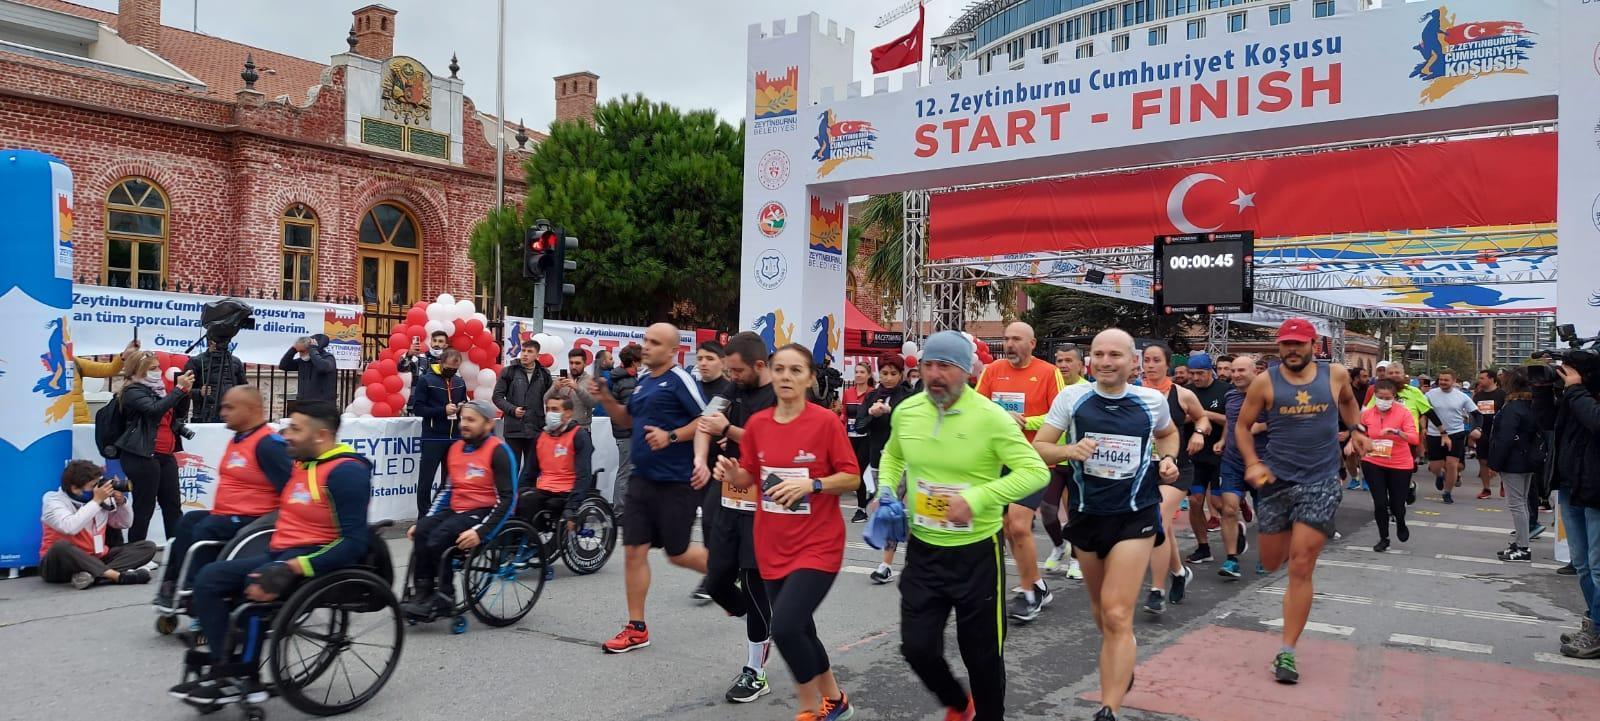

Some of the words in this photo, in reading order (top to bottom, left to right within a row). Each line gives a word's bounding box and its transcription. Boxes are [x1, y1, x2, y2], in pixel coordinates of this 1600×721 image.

[915, 97, 944, 118] 12.
[950, 76, 1082, 115] Zeytinburnu
[1088, 48, 1236, 91] Cumhuriyet
[1245, 35, 1342, 68] Koşusu
[1445, 54, 1519, 80] KOŞUSU
[914, 102, 1071, 158] START
[1091, 112, 1109, 124] -
[1131, 62, 1342, 130] FINISH
[1170, 253, 1234, 270] 00:00:45
[72, 292, 163, 310] Zeytinburnu
[253, 308, 306, 320] oşusu'na
[95, 311, 126, 324] tüm
[129, 315, 204, 329] sporculara
[263, 321, 311, 334] dilerim.
[155, 333, 194, 348] Ömer
[1091, 447, 1131, 464] H-1044
